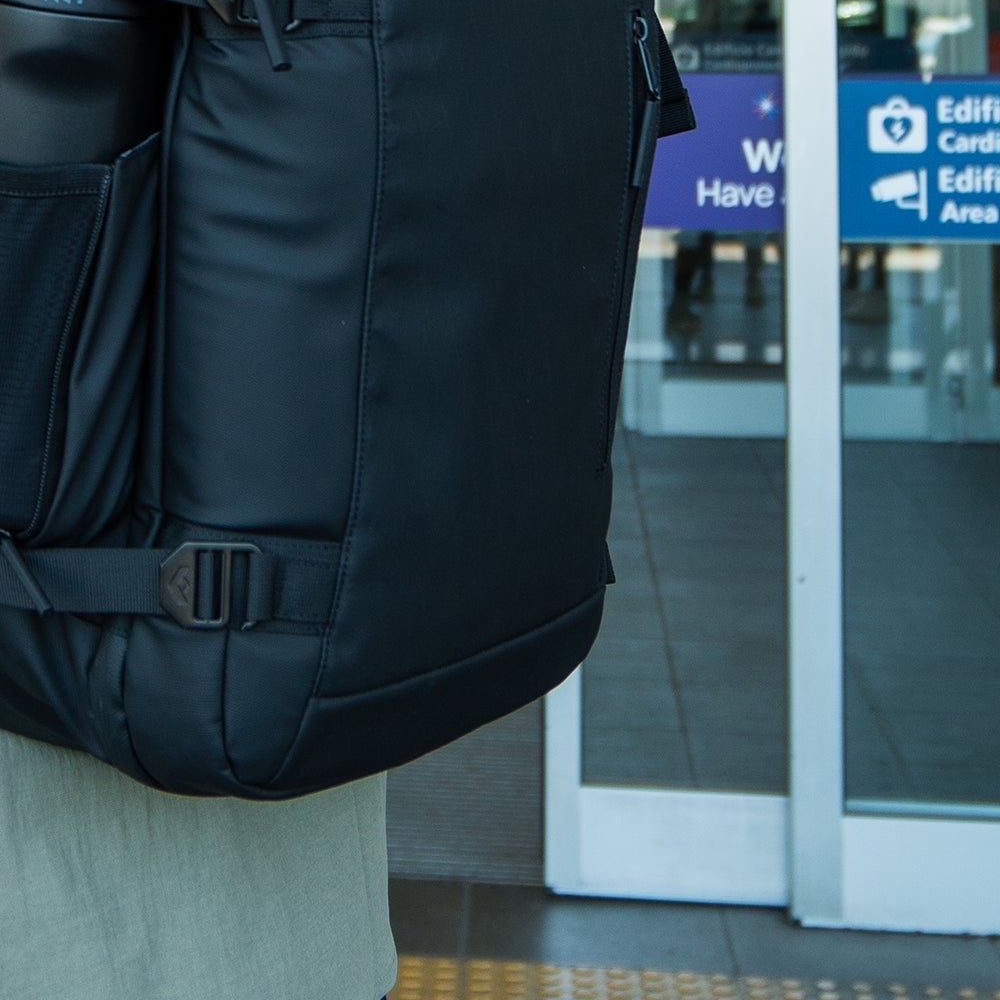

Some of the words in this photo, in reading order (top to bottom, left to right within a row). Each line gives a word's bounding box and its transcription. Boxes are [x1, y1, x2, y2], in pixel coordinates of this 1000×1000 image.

[742, 138, 784, 174] W
[696, 177, 775, 208] Have
[940, 200, 999, 223] Area
